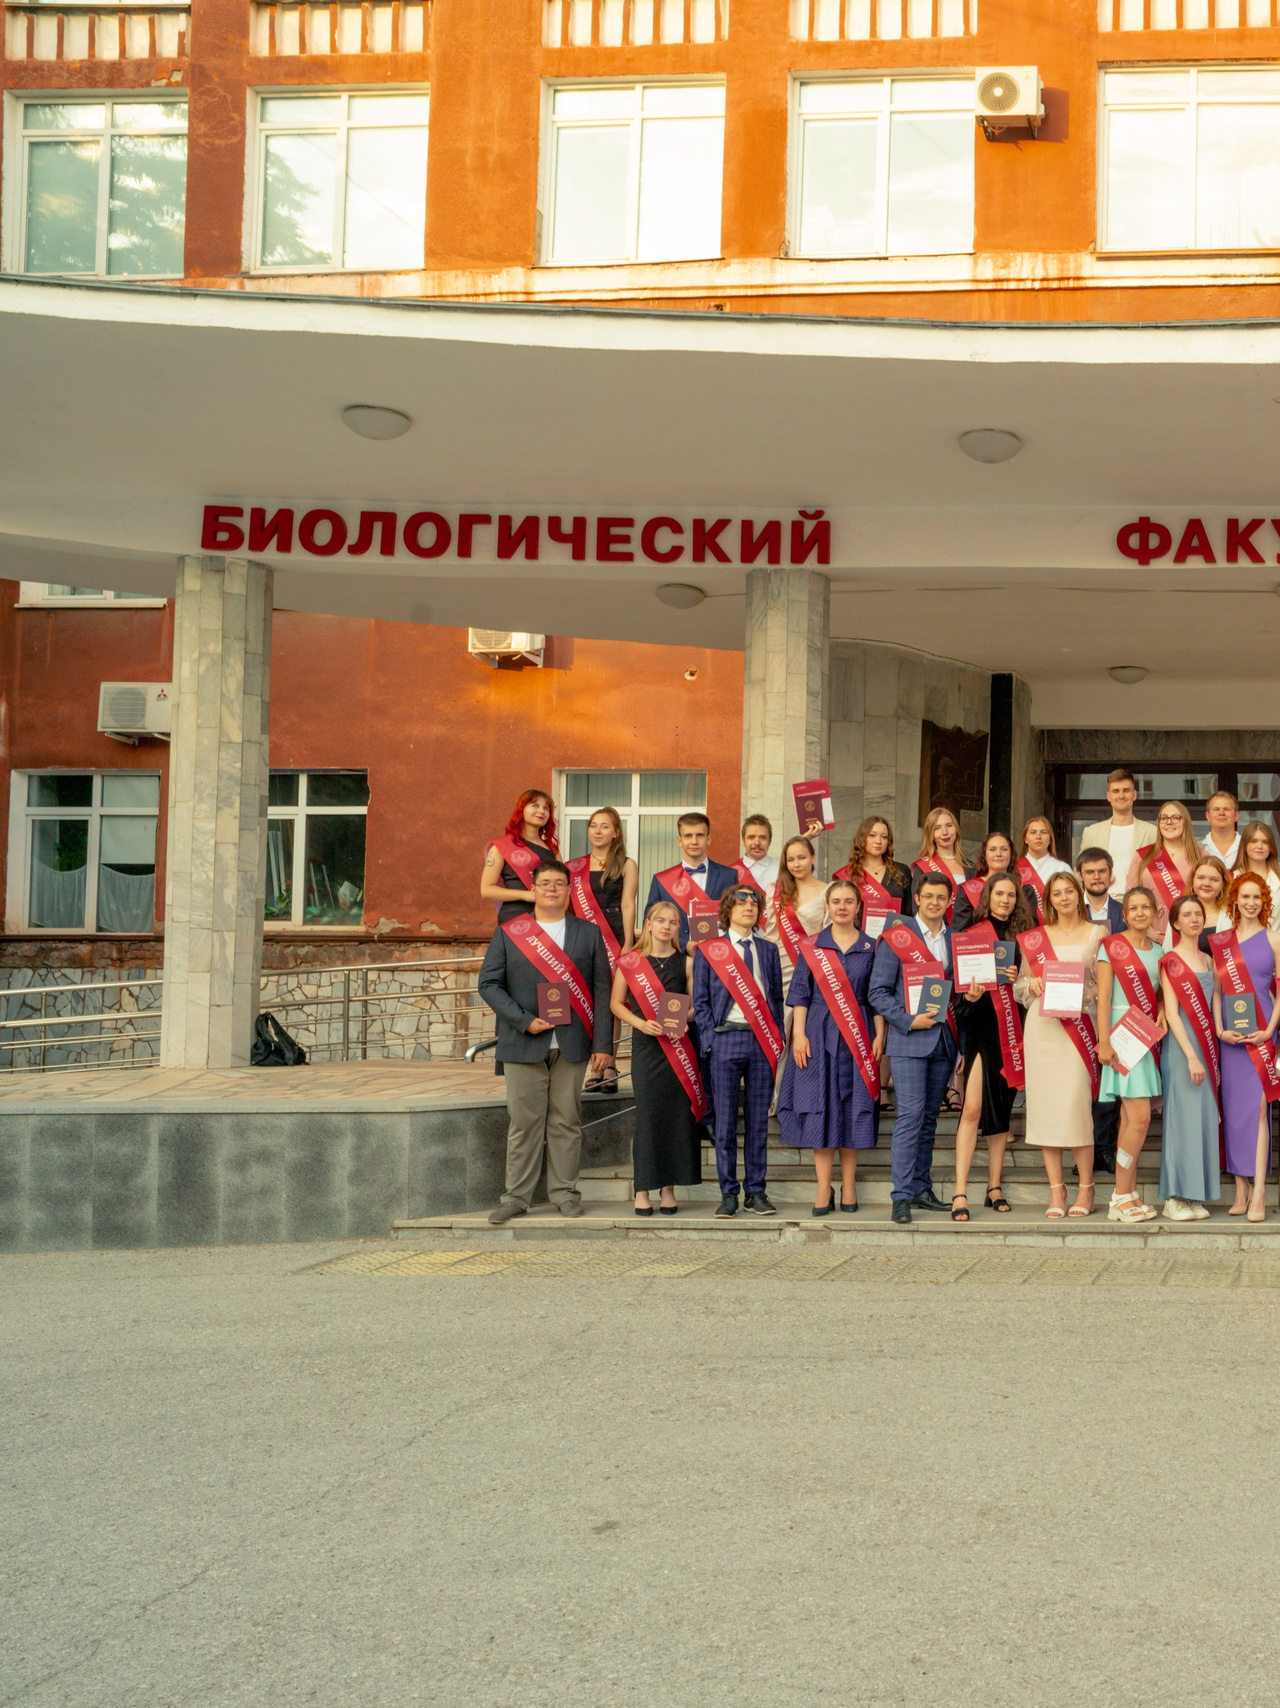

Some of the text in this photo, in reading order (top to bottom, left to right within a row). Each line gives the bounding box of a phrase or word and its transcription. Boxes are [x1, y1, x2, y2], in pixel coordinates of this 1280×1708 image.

[201, 504, 831, 565] БИОЛОГИЧЕСКИЙ
[526, 936, 565, 974] ЛУЧШИЙ
[1222, 947, 1245, 993] ЛУЧШИЙ
[726, 964, 757, 1009] ЛУЧШИЙ
[1124, 965, 1152, 1013] ЛУЧШИЙ
[1182, 981, 1206, 1029] ЛУЧШИЙ
[814, 948, 875, 1081] ЛУЧШИЙ ВЫПУСКНИК 2024
[1011, 1048, 1022, 1072] 2024
[1266, 1059, 1279, 1086] 2024
